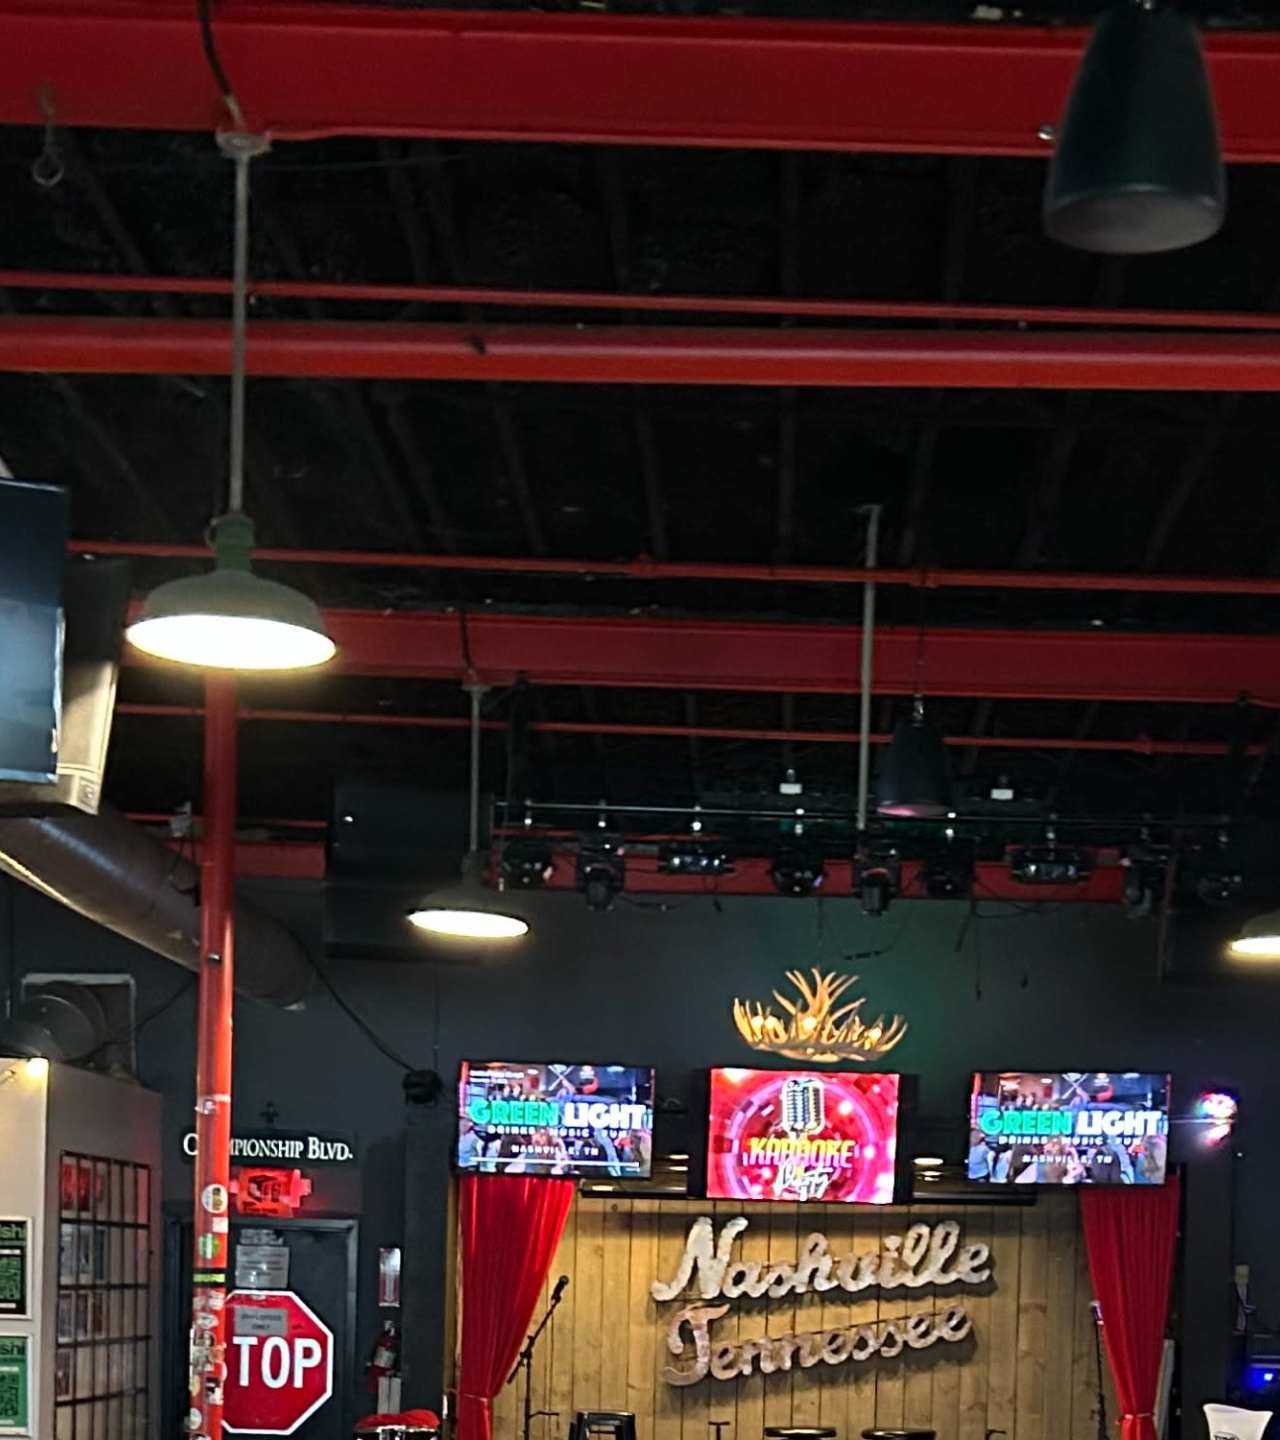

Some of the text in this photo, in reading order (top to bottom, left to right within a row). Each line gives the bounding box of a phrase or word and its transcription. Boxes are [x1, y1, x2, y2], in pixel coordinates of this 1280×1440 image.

[469, 1101, 647, 1128] GREEN LIGHT
[979, 1110, 1163, 1135] GREEN LIGHT
[749, 1136, 856, 1169] KARAOKE
[650, 1216, 991, 1301] Nashville
[225, 1335, 322, 1389] TOP
[663, 1301, 973, 1386] Tennessee
